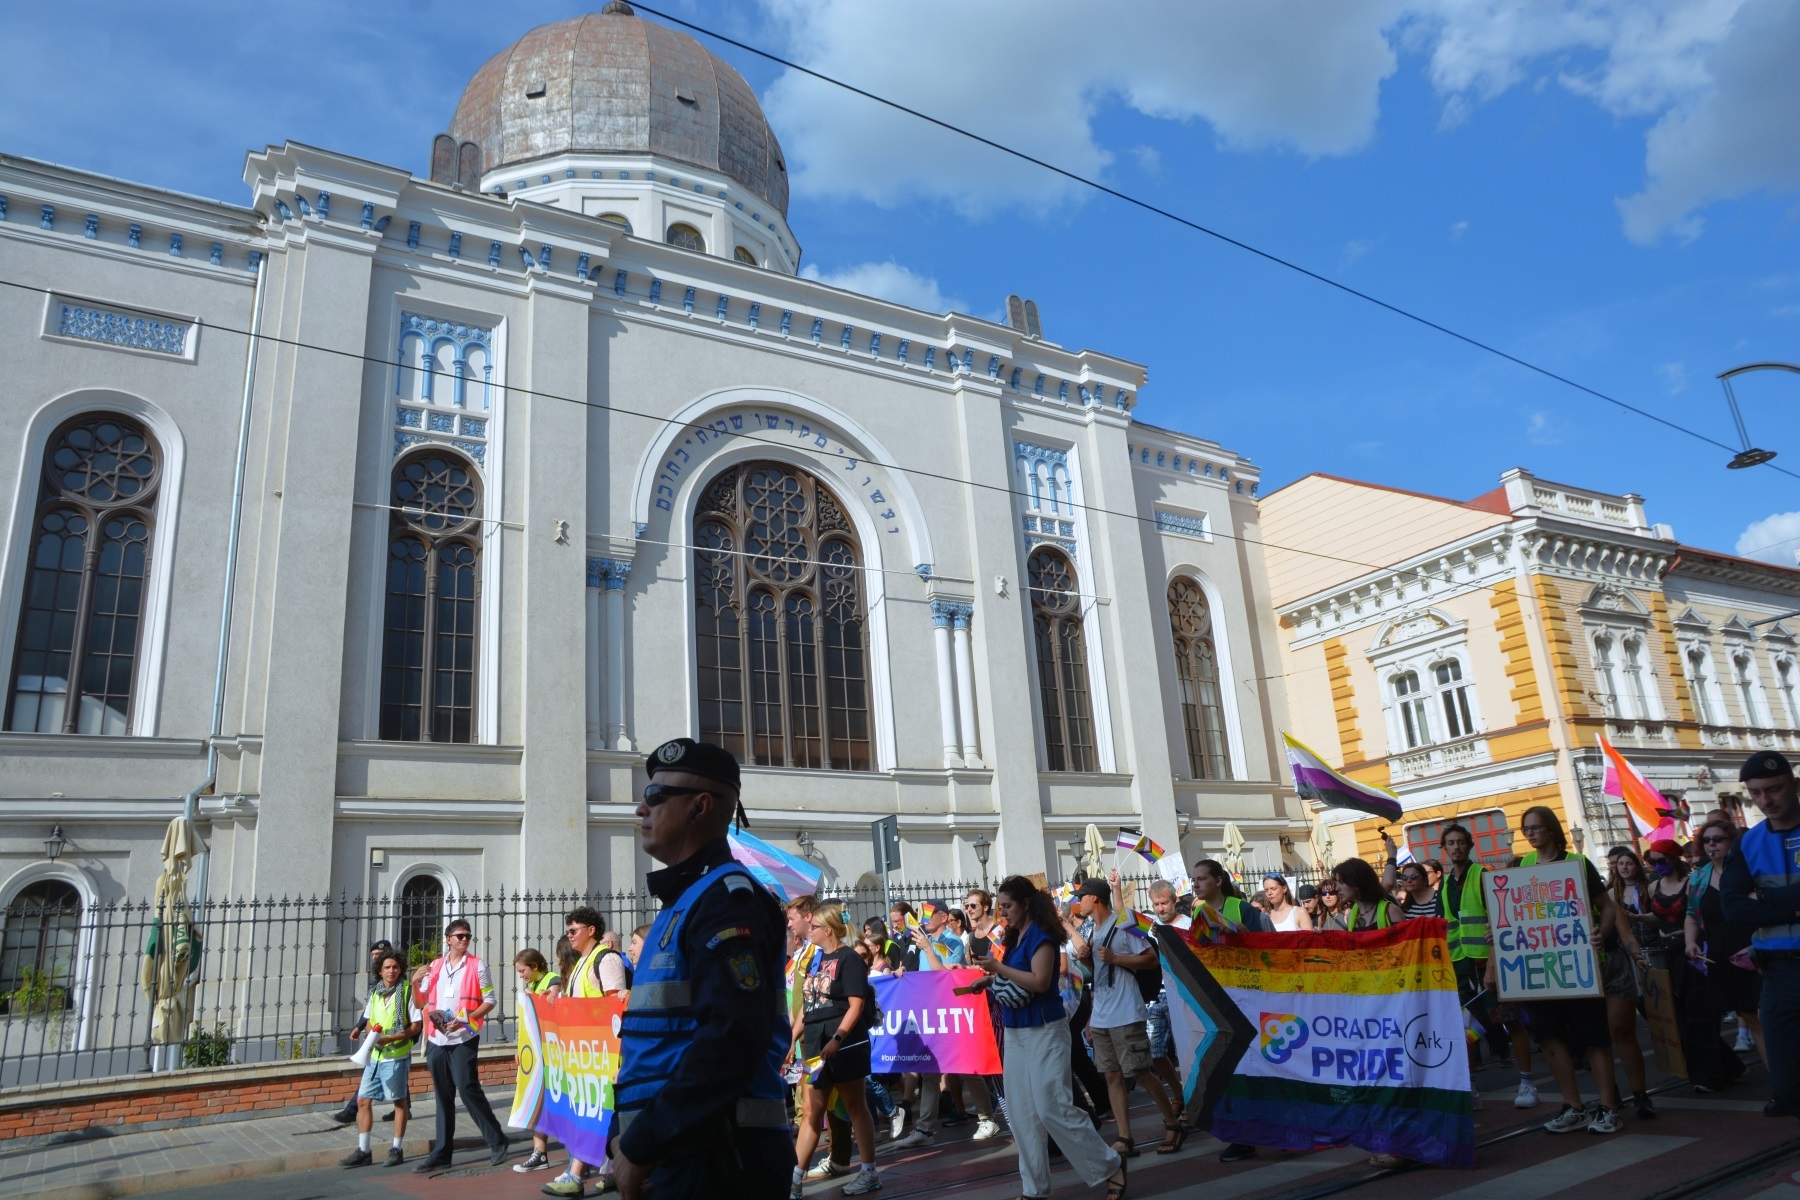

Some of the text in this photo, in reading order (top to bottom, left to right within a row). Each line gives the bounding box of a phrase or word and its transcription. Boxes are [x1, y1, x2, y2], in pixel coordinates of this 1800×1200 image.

[1500, 949, 1594, 992] MEREU
[869, 1007, 974, 1036] UALITY
[1312, 1015, 1403, 1040] ORADEA
[559, 1038, 610, 1071] RADEA
[1415, 1031, 1443, 1050] Ark
[1311, 1046, 1404, 1082] PRIDE
[565, 1072, 609, 1122] RIDE
